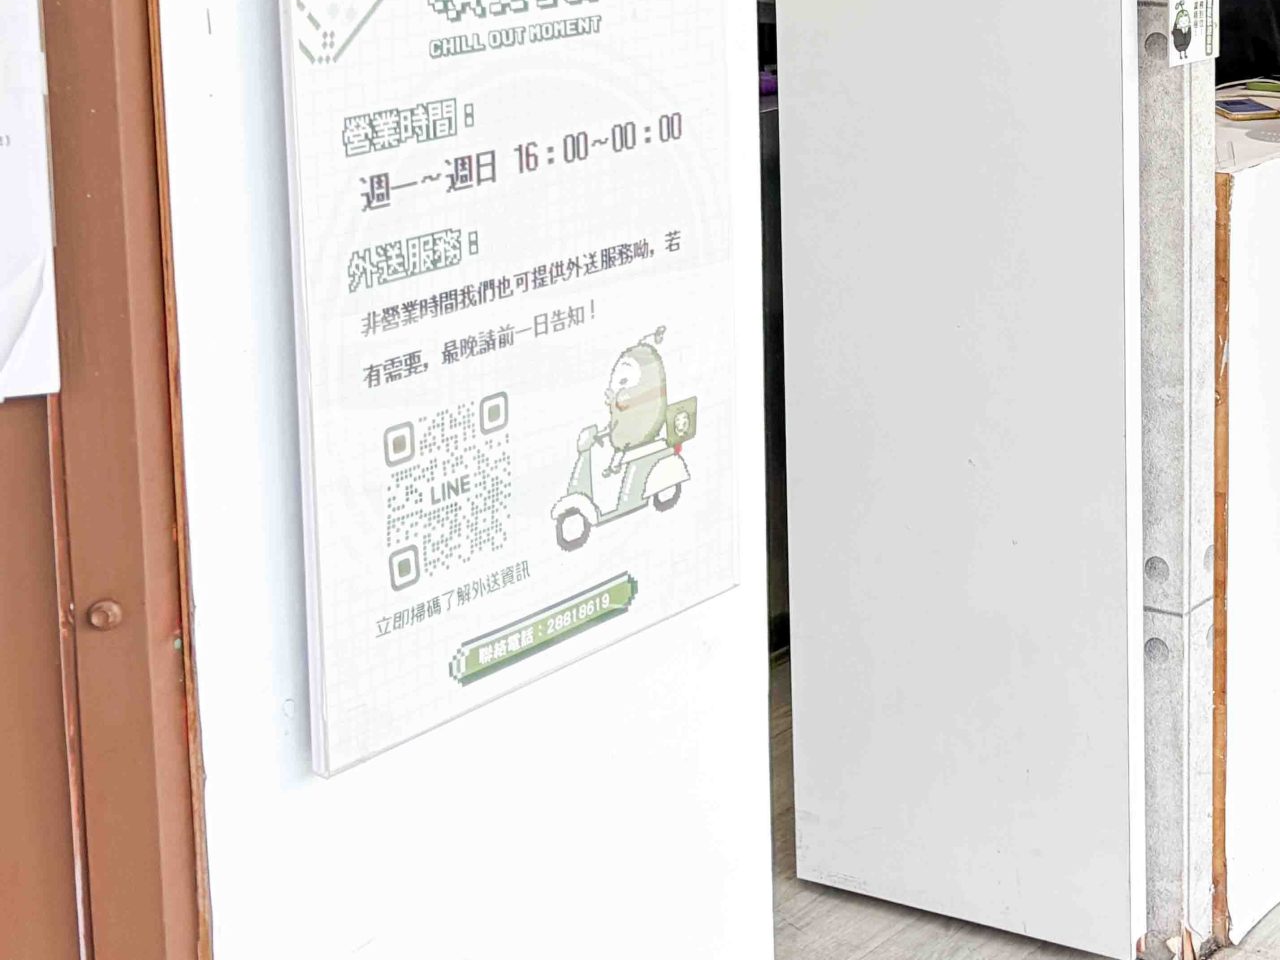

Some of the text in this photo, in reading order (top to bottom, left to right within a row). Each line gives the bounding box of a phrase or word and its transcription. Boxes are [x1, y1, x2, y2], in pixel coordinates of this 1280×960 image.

[429, 15, 602, 58] CHILL OUT MOMENT
[428, 474, 472, 506] LINE
[376, 559, 532, 639] 立即掃碼了解外送資訊
